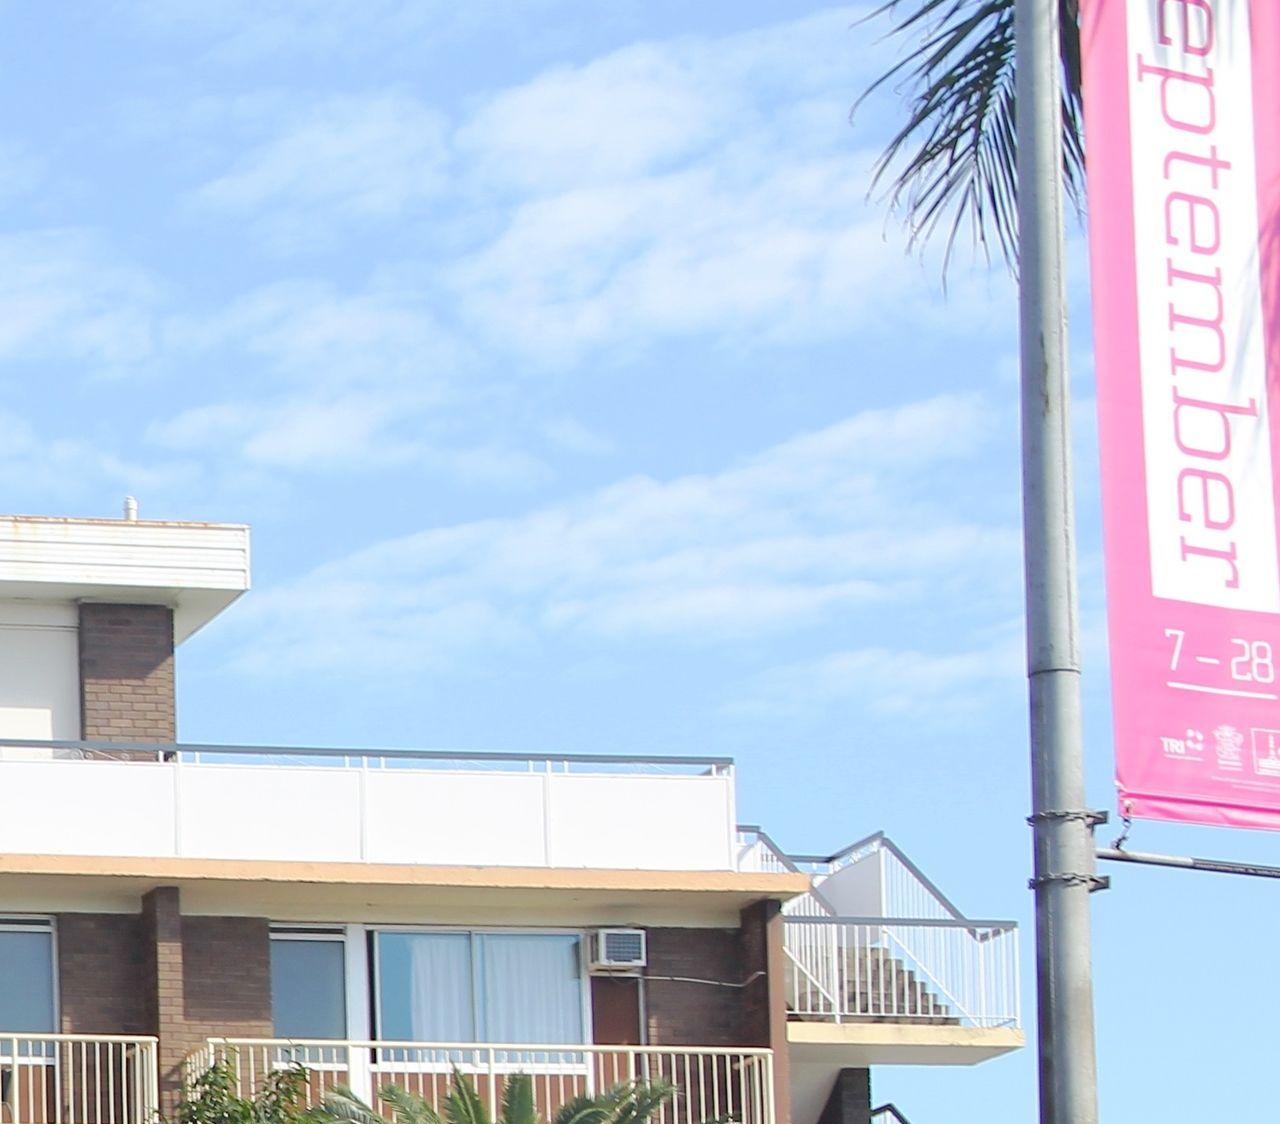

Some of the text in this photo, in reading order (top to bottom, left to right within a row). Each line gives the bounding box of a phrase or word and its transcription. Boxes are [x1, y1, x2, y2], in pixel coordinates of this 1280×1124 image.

[1164, 628, 1185, 671] 7
[1230, 638, 1275, 683] 28
[1160, 736, 1186, 755] TRI
